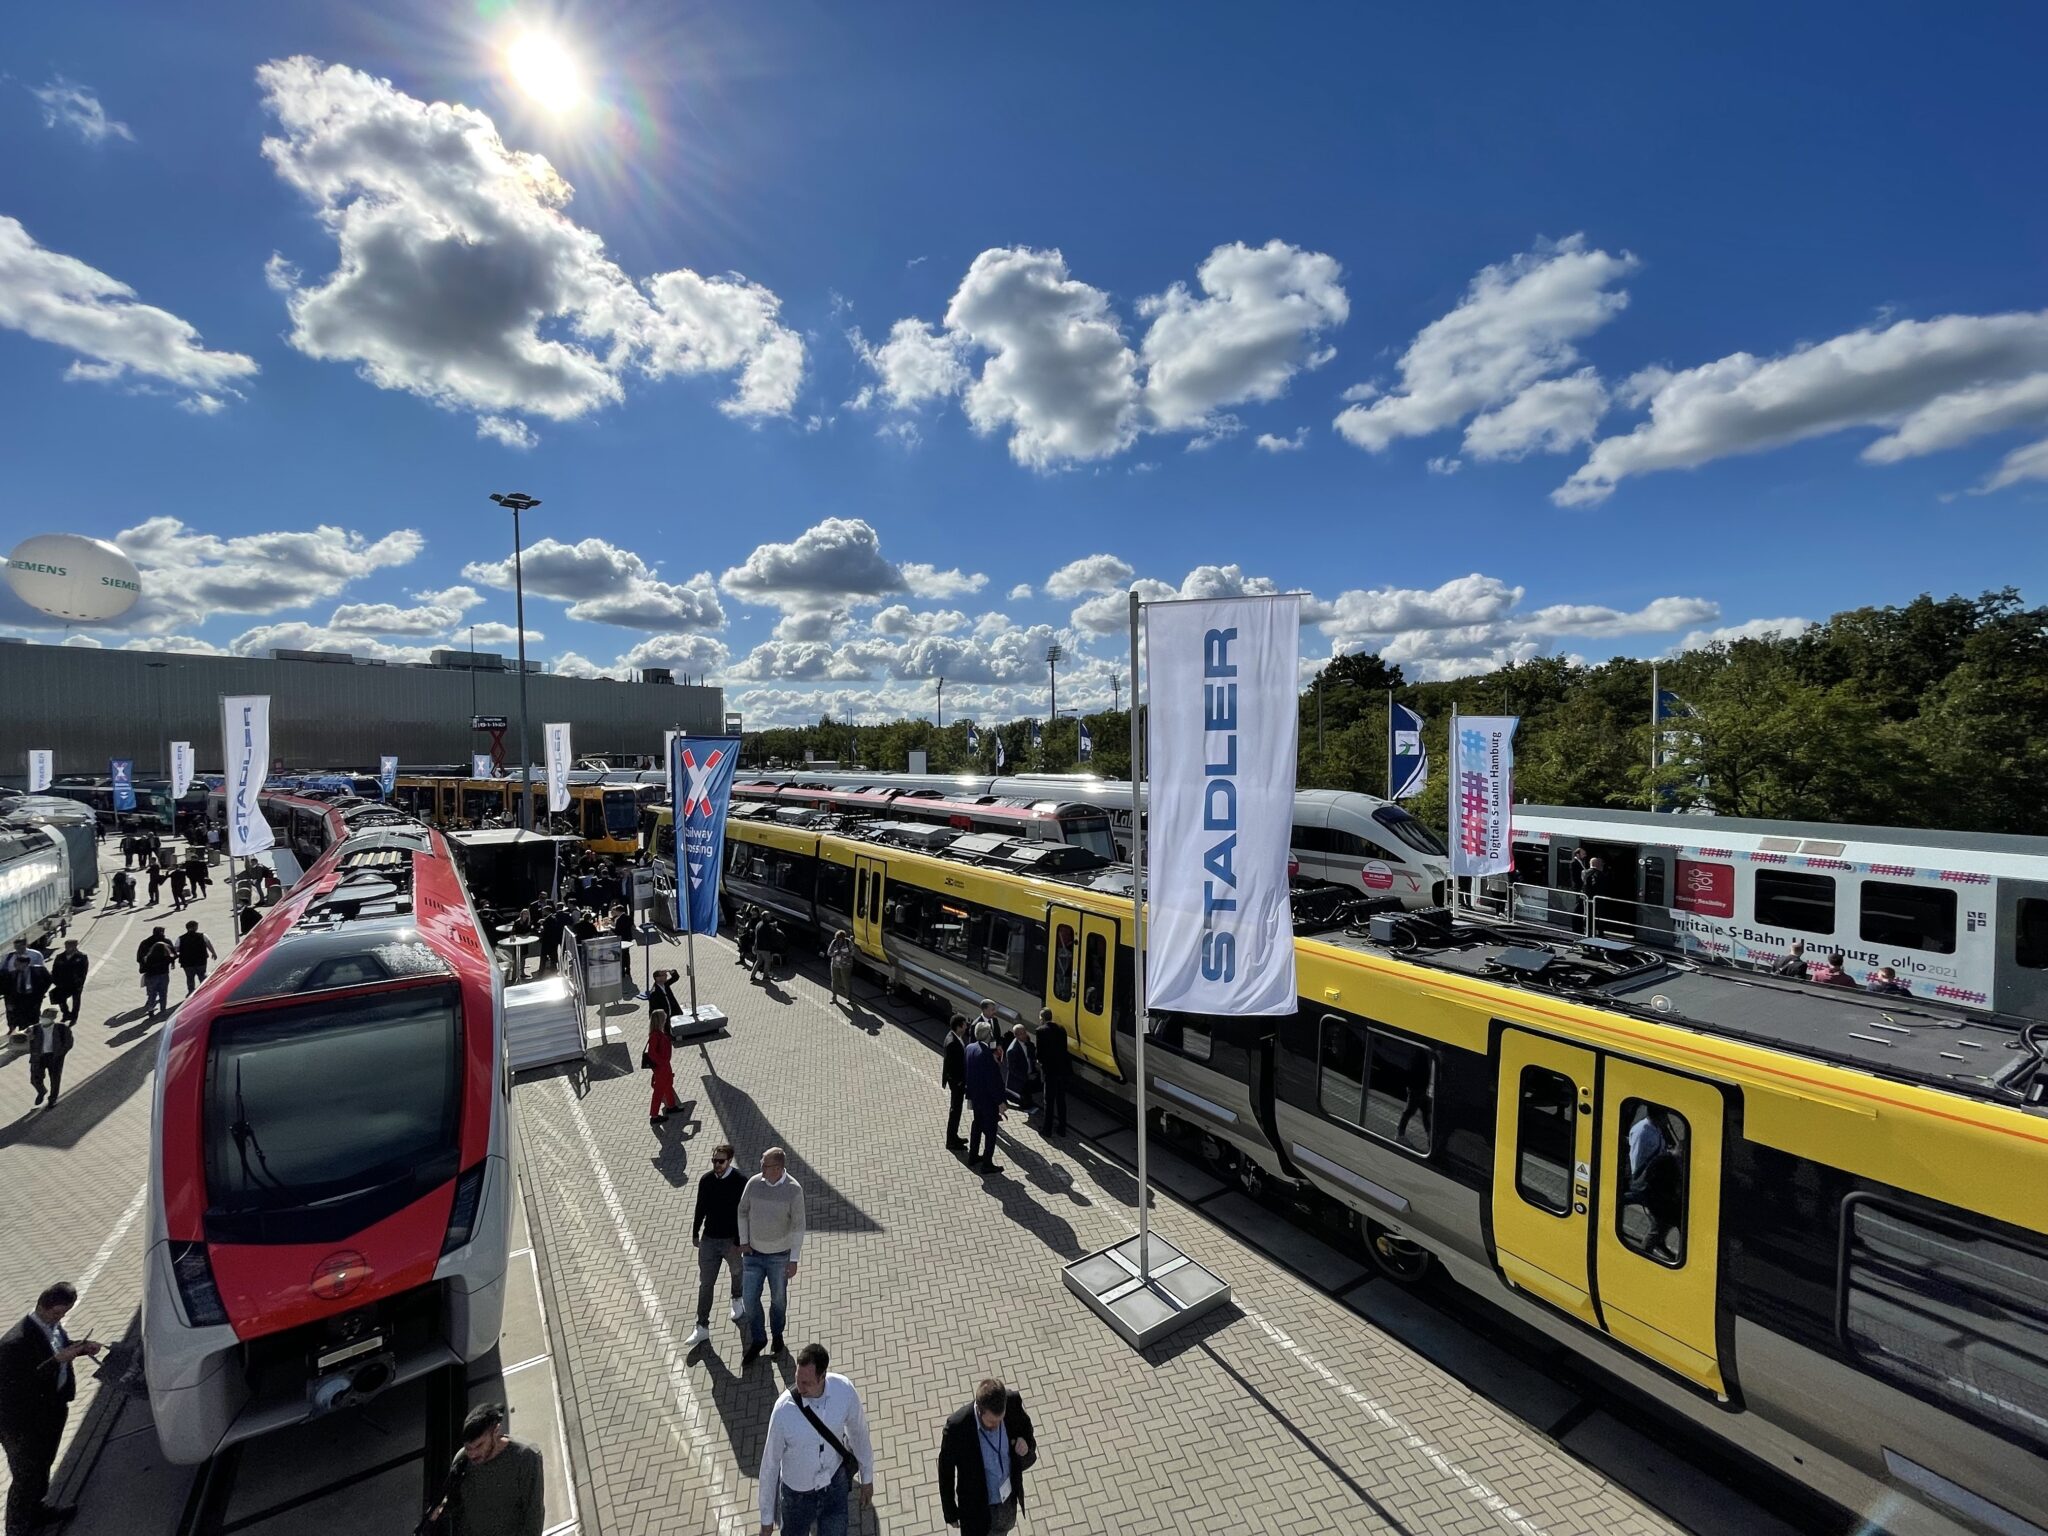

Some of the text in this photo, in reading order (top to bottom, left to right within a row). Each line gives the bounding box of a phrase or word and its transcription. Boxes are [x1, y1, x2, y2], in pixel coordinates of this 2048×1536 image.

[236, 707, 252, 844] STADLER
[1202, 627, 1238, 983] STADLER
[1490, 732, 1502, 859] Digitale S-Bahn Hamburg
[684, 827, 713, 841] ailway
[1728, 926, 1785, 947] S-Bahn
[1928, 965, 1958, 978] 2021
